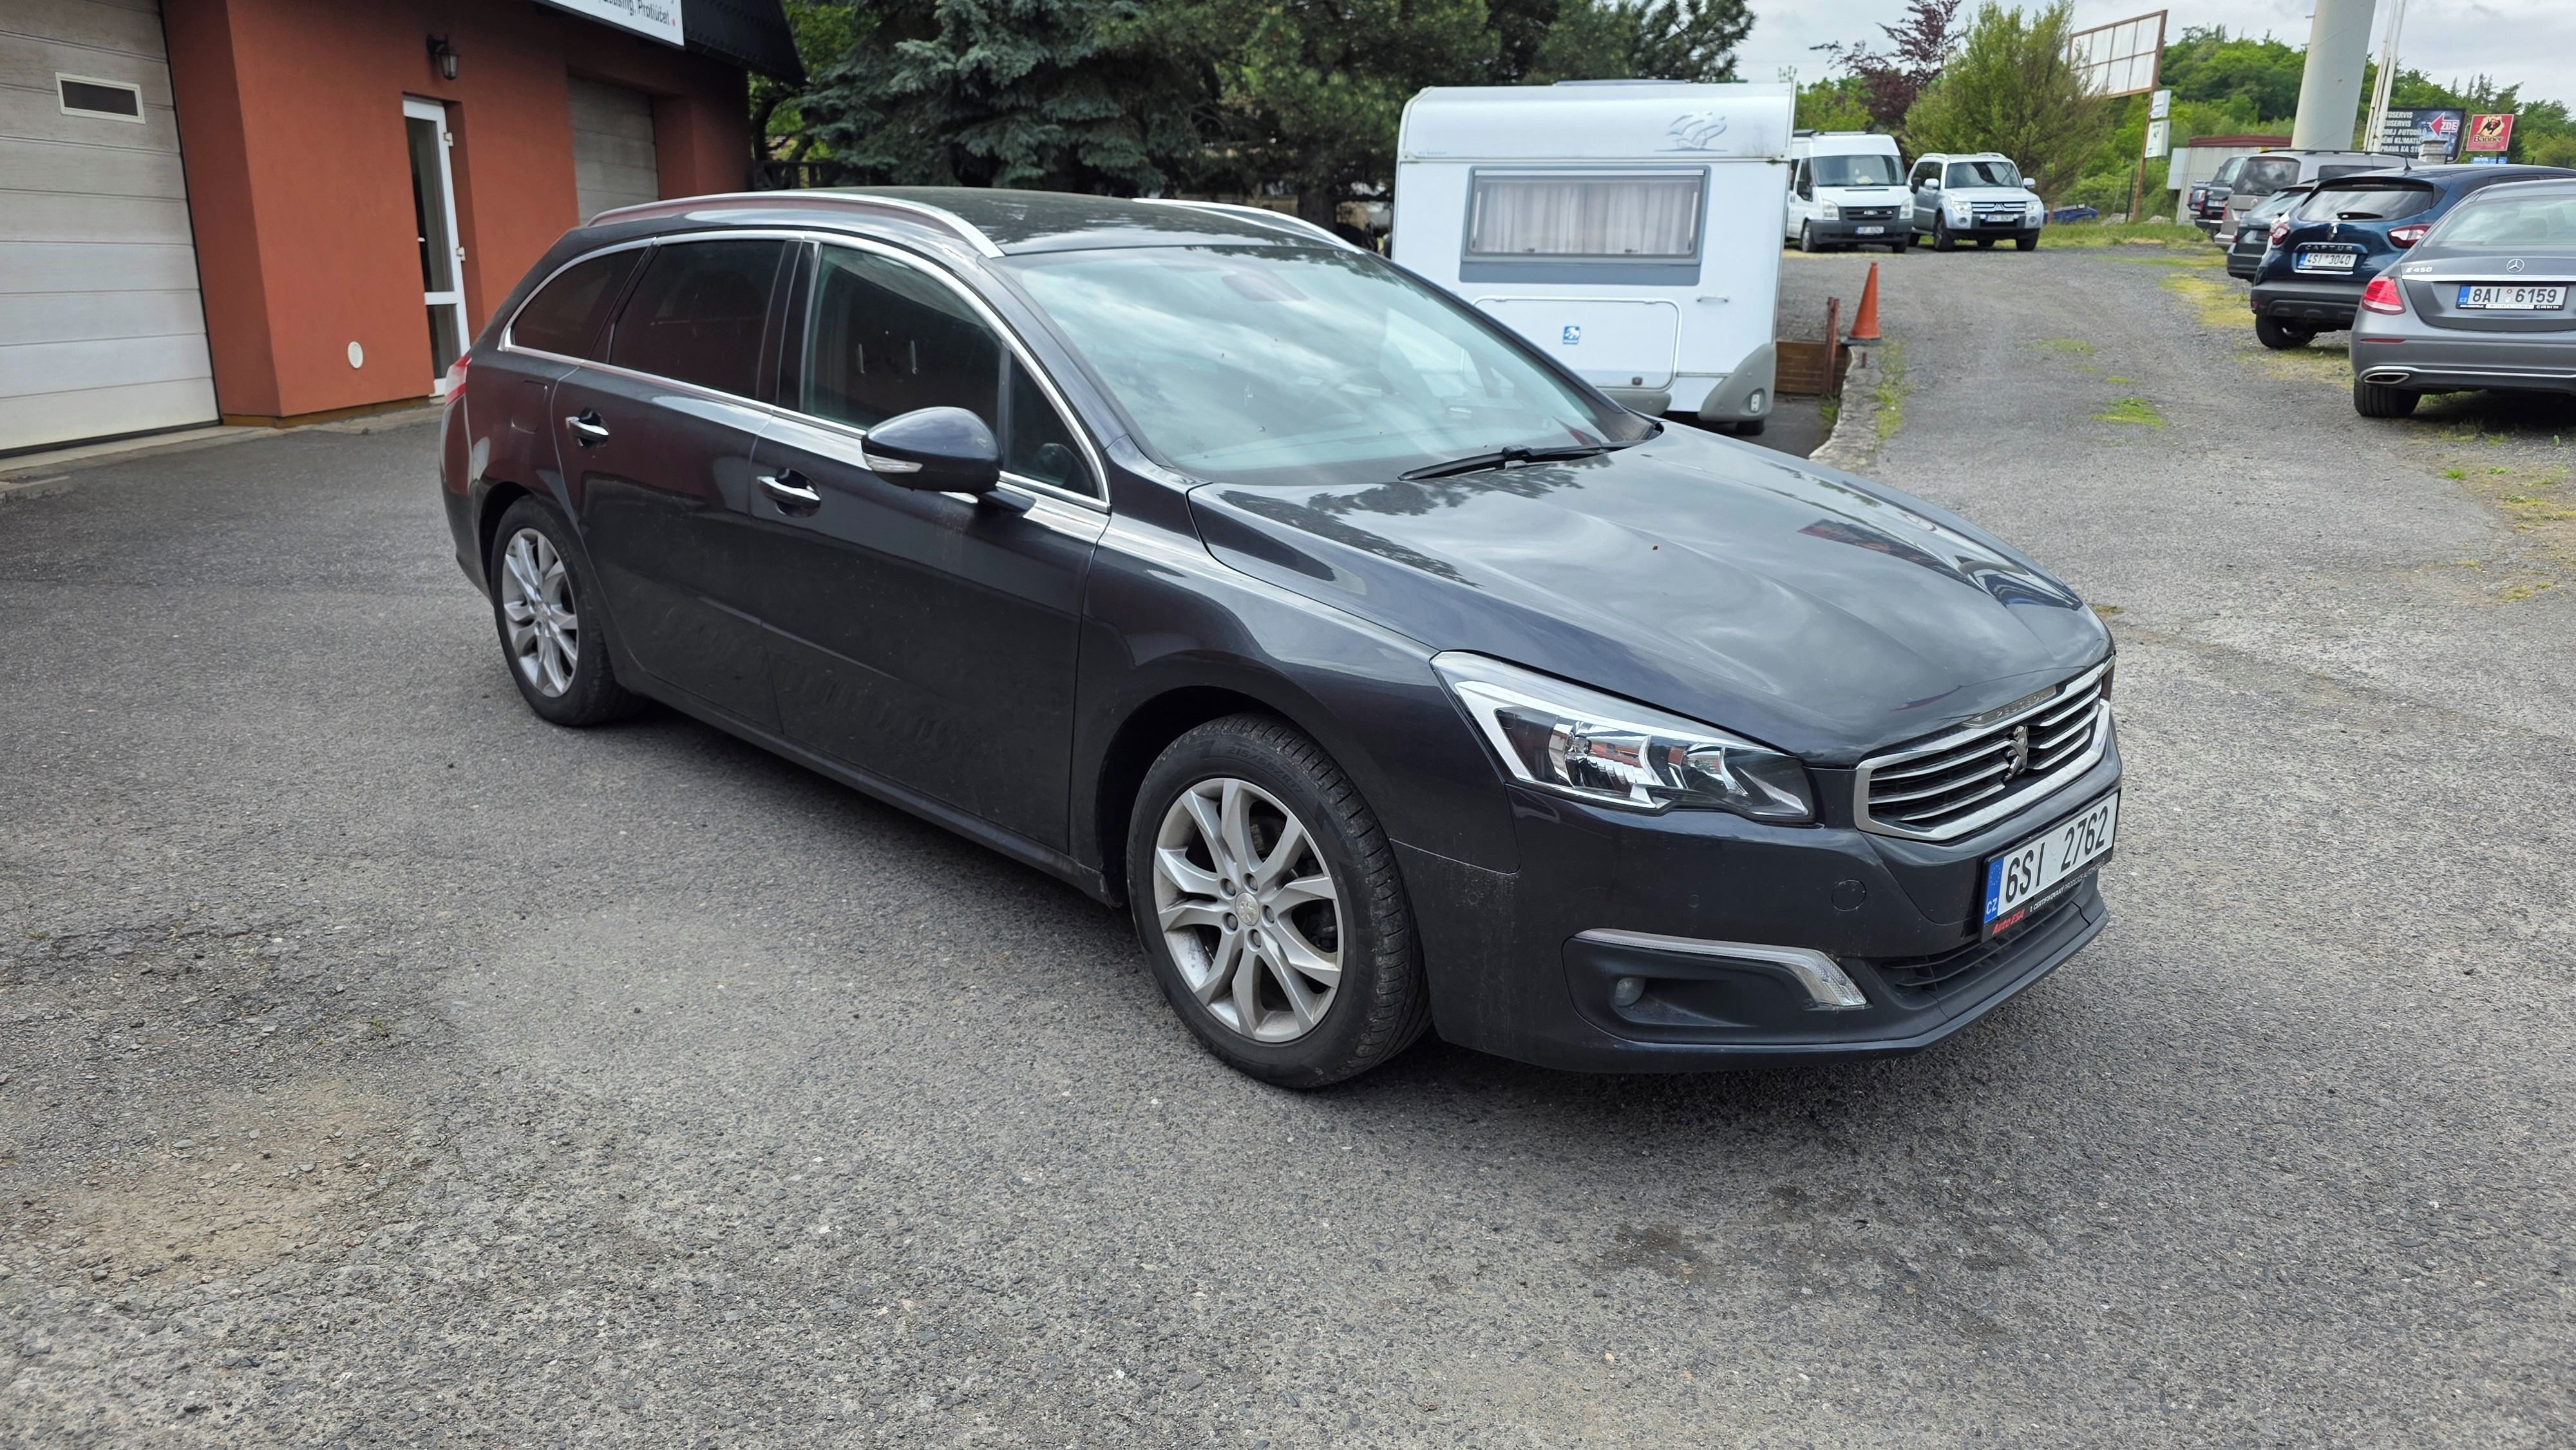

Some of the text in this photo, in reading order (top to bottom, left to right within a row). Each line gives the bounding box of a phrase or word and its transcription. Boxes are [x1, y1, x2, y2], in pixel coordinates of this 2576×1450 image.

[2440, 121, 2458, 131] ZDE
[2307, 254, 2351, 265] 4SI 3040
[2472, 288, 2501, 303] 8AI
[2515, 288, 2557, 303] 6159
[1985, 805, 2108, 916] CZ 6SI 2762
